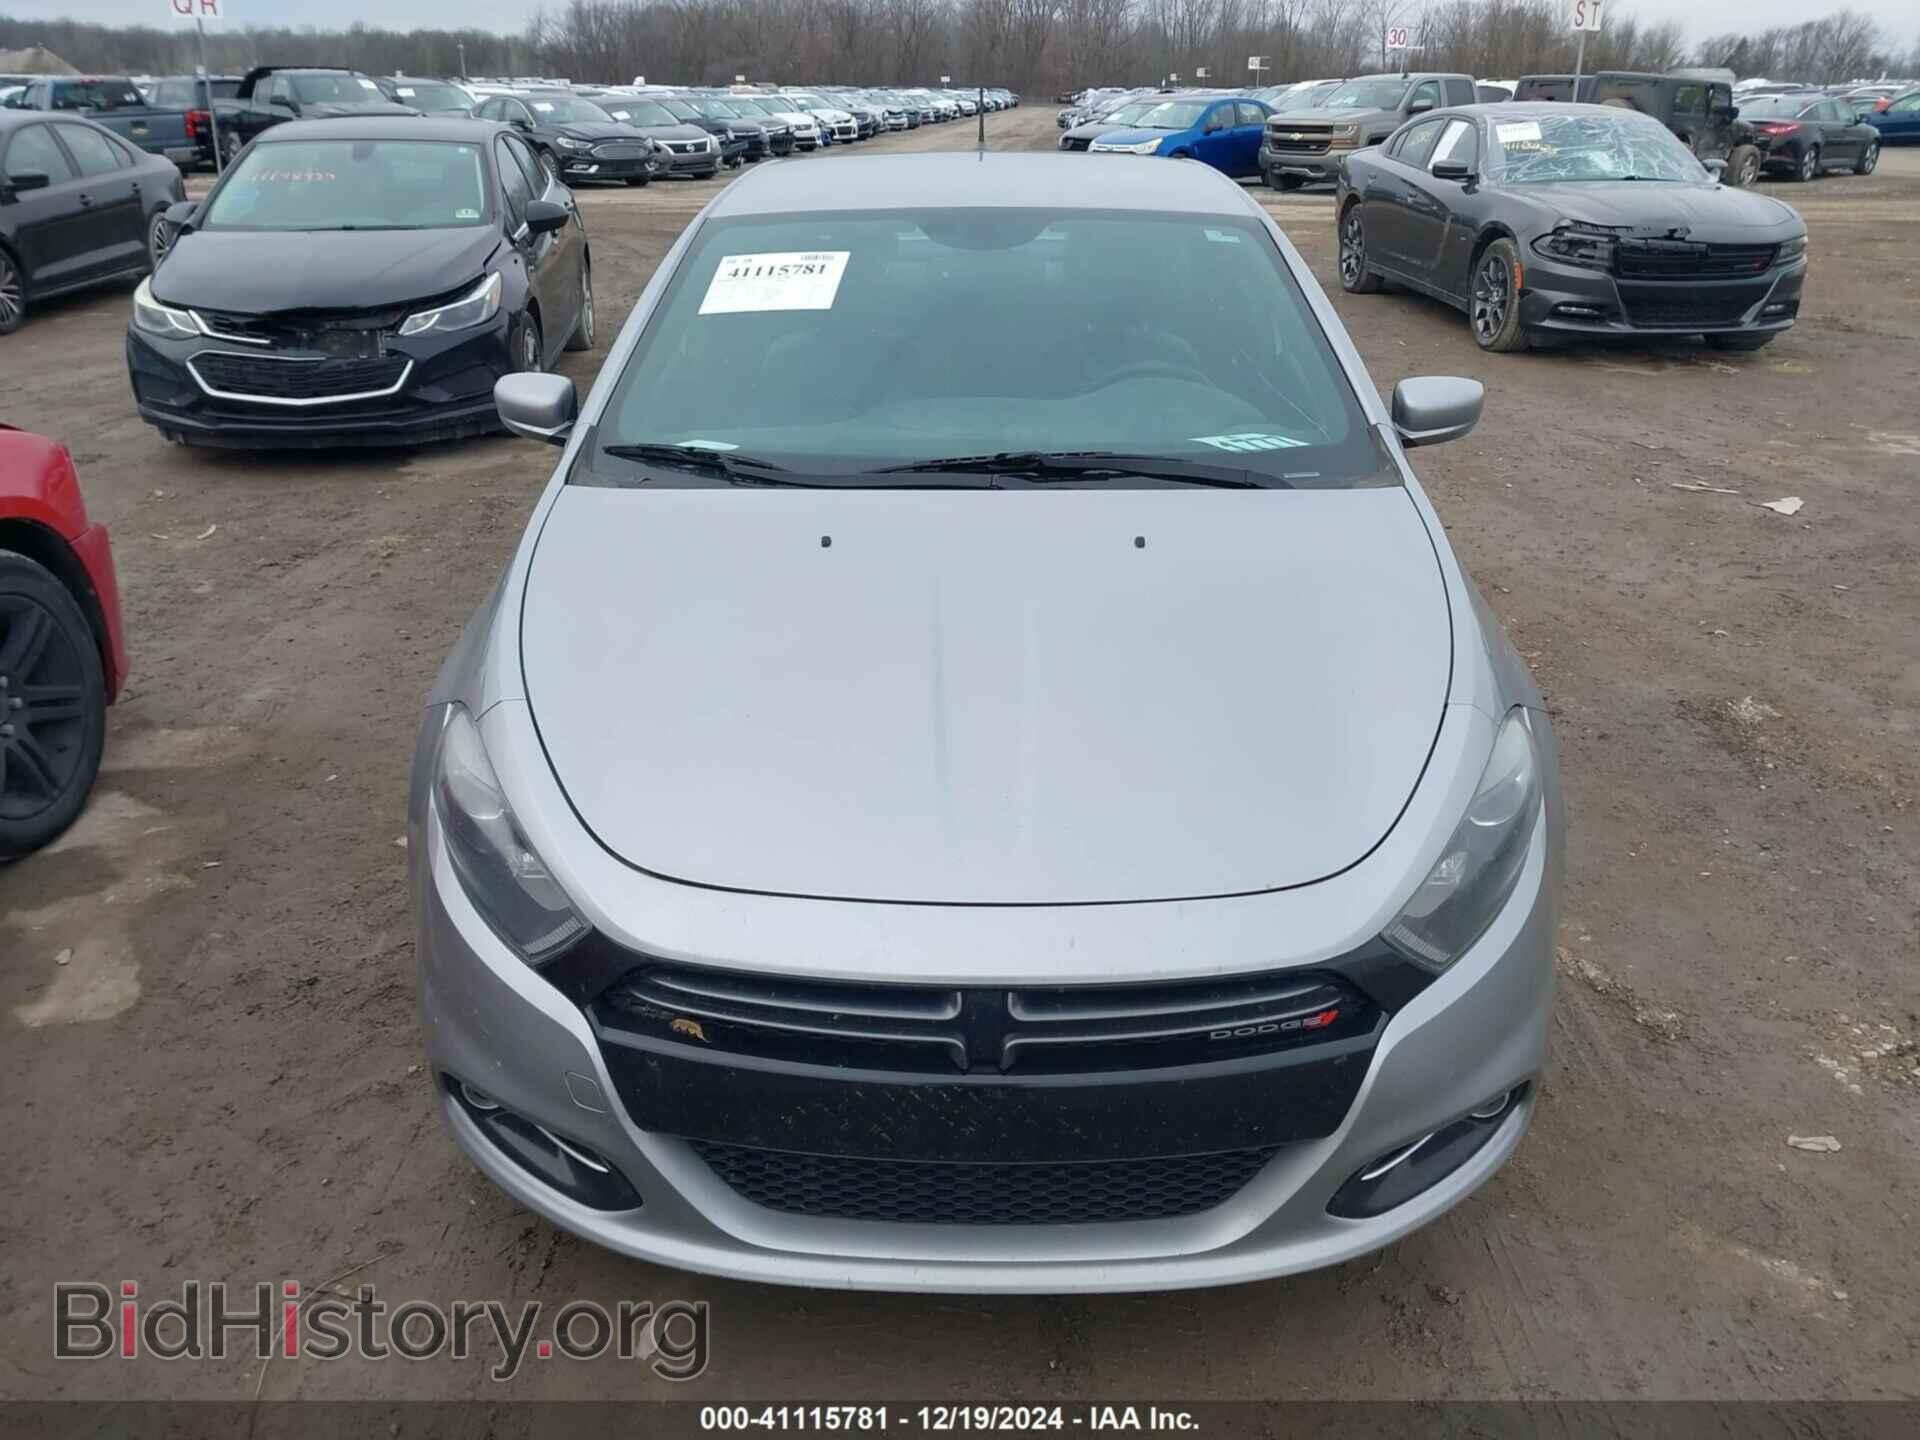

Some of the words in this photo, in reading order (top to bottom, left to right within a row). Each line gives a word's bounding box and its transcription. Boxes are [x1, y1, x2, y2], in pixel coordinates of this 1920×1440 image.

[1389, 28, 1407, 46] 30
[728, 264, 826, 278] 41115781
[1209, 1017, 1322, 1040] DODGE
